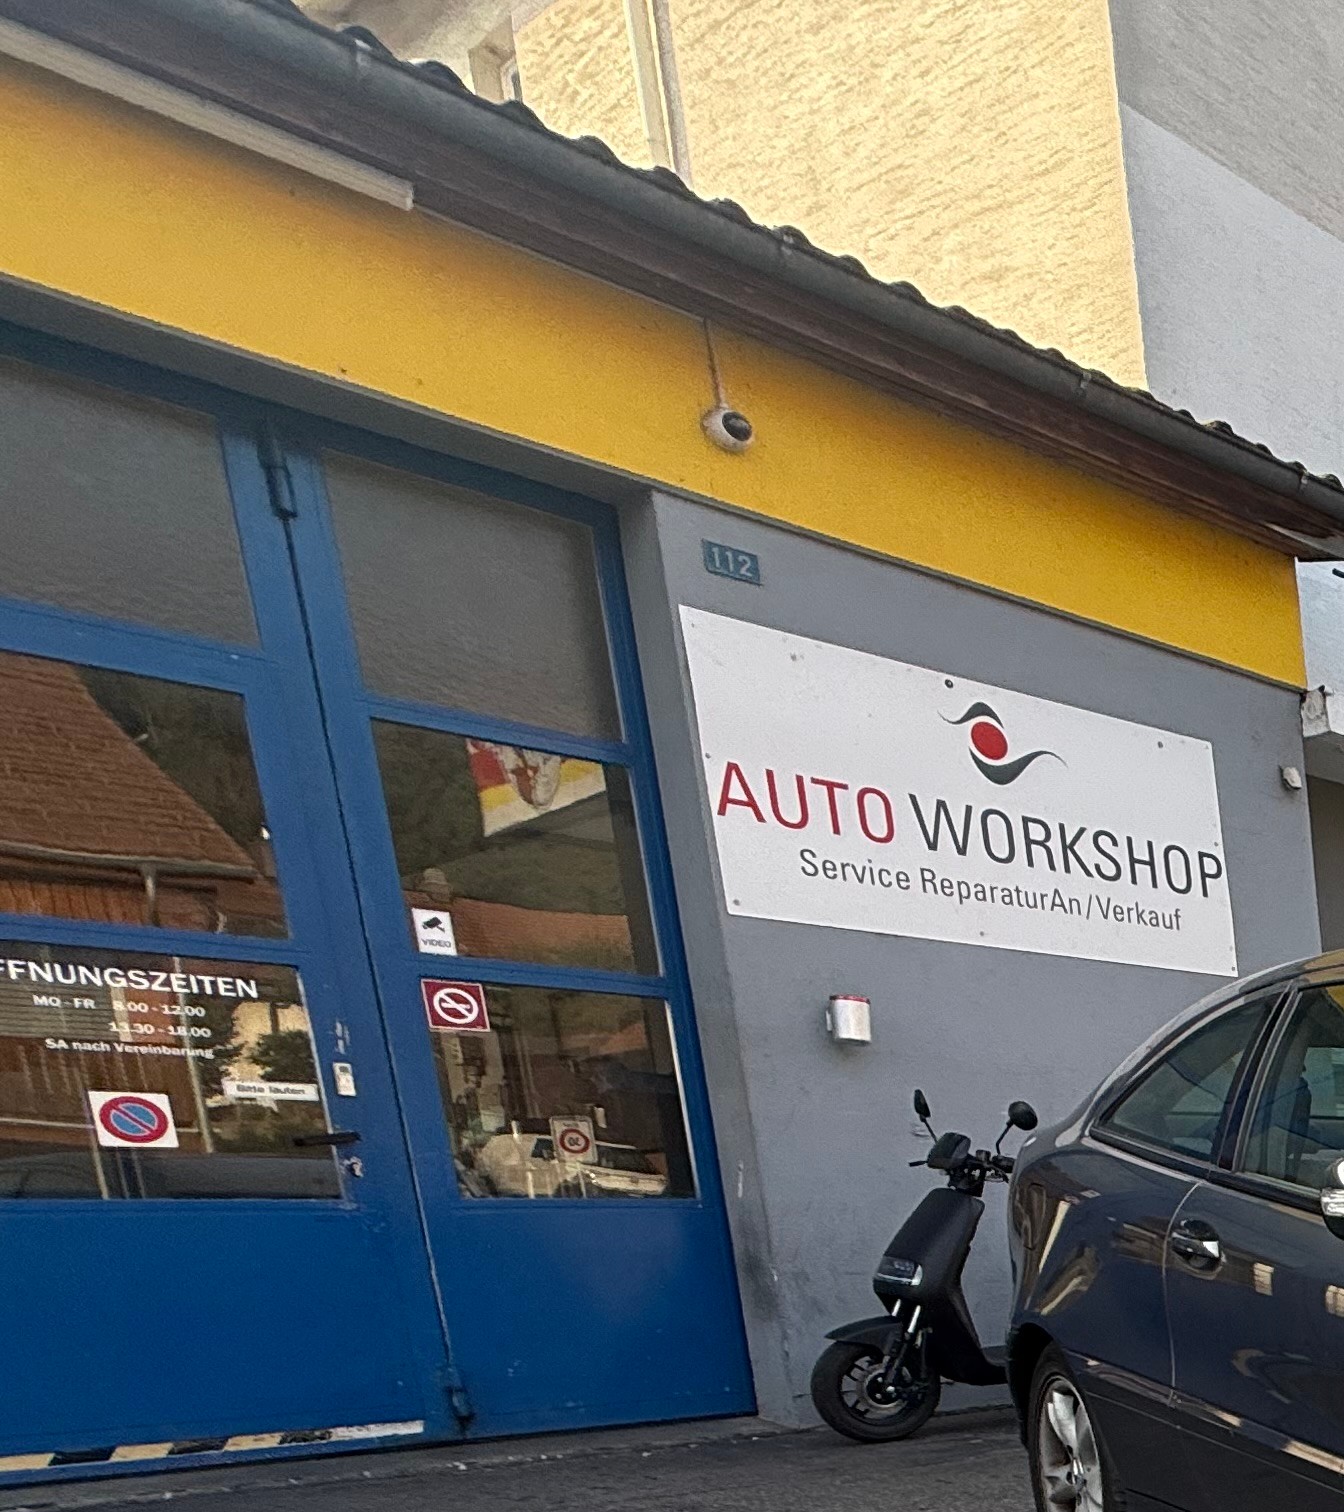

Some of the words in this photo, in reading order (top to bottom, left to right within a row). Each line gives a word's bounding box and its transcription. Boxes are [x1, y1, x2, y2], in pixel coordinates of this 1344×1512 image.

[711, 546, 753, 577] 112
[716, 760, 896, 844] AUTO
[907, 792, 1224, 898] WORKSHOP
[799, 848, 911, 890] Service
[421, 938, 452, 948] VIDEO
[0, 957, 259, 999] FNUNGSZEITEN
[32, 994, 61, 1009] MO
[73, 997, 97, 1010] FR
[45, 1038, 69, 1050] SA
[72, 1041, 111, 1052] nach
[113, 1042, 215, 1060] Vereinbarung
